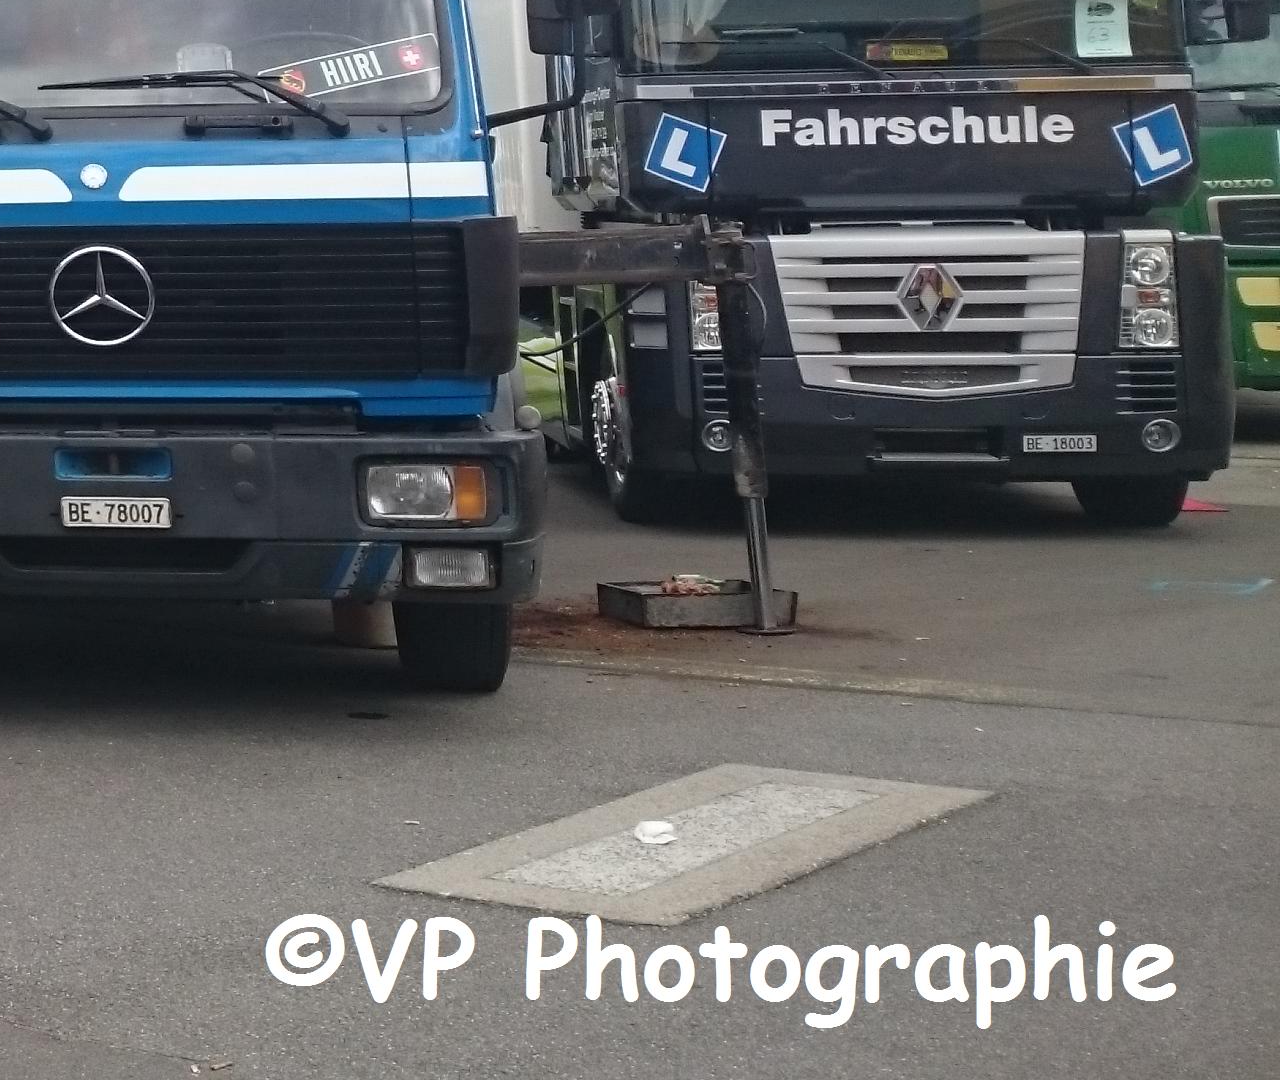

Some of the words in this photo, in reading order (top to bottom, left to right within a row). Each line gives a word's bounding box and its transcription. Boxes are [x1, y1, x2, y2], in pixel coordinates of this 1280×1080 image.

[320, 50, 383, 87] HIIRI
[760, 105, 1075, 147] Fahrschule
[1202, 178, 1274, 189] VOLVO
